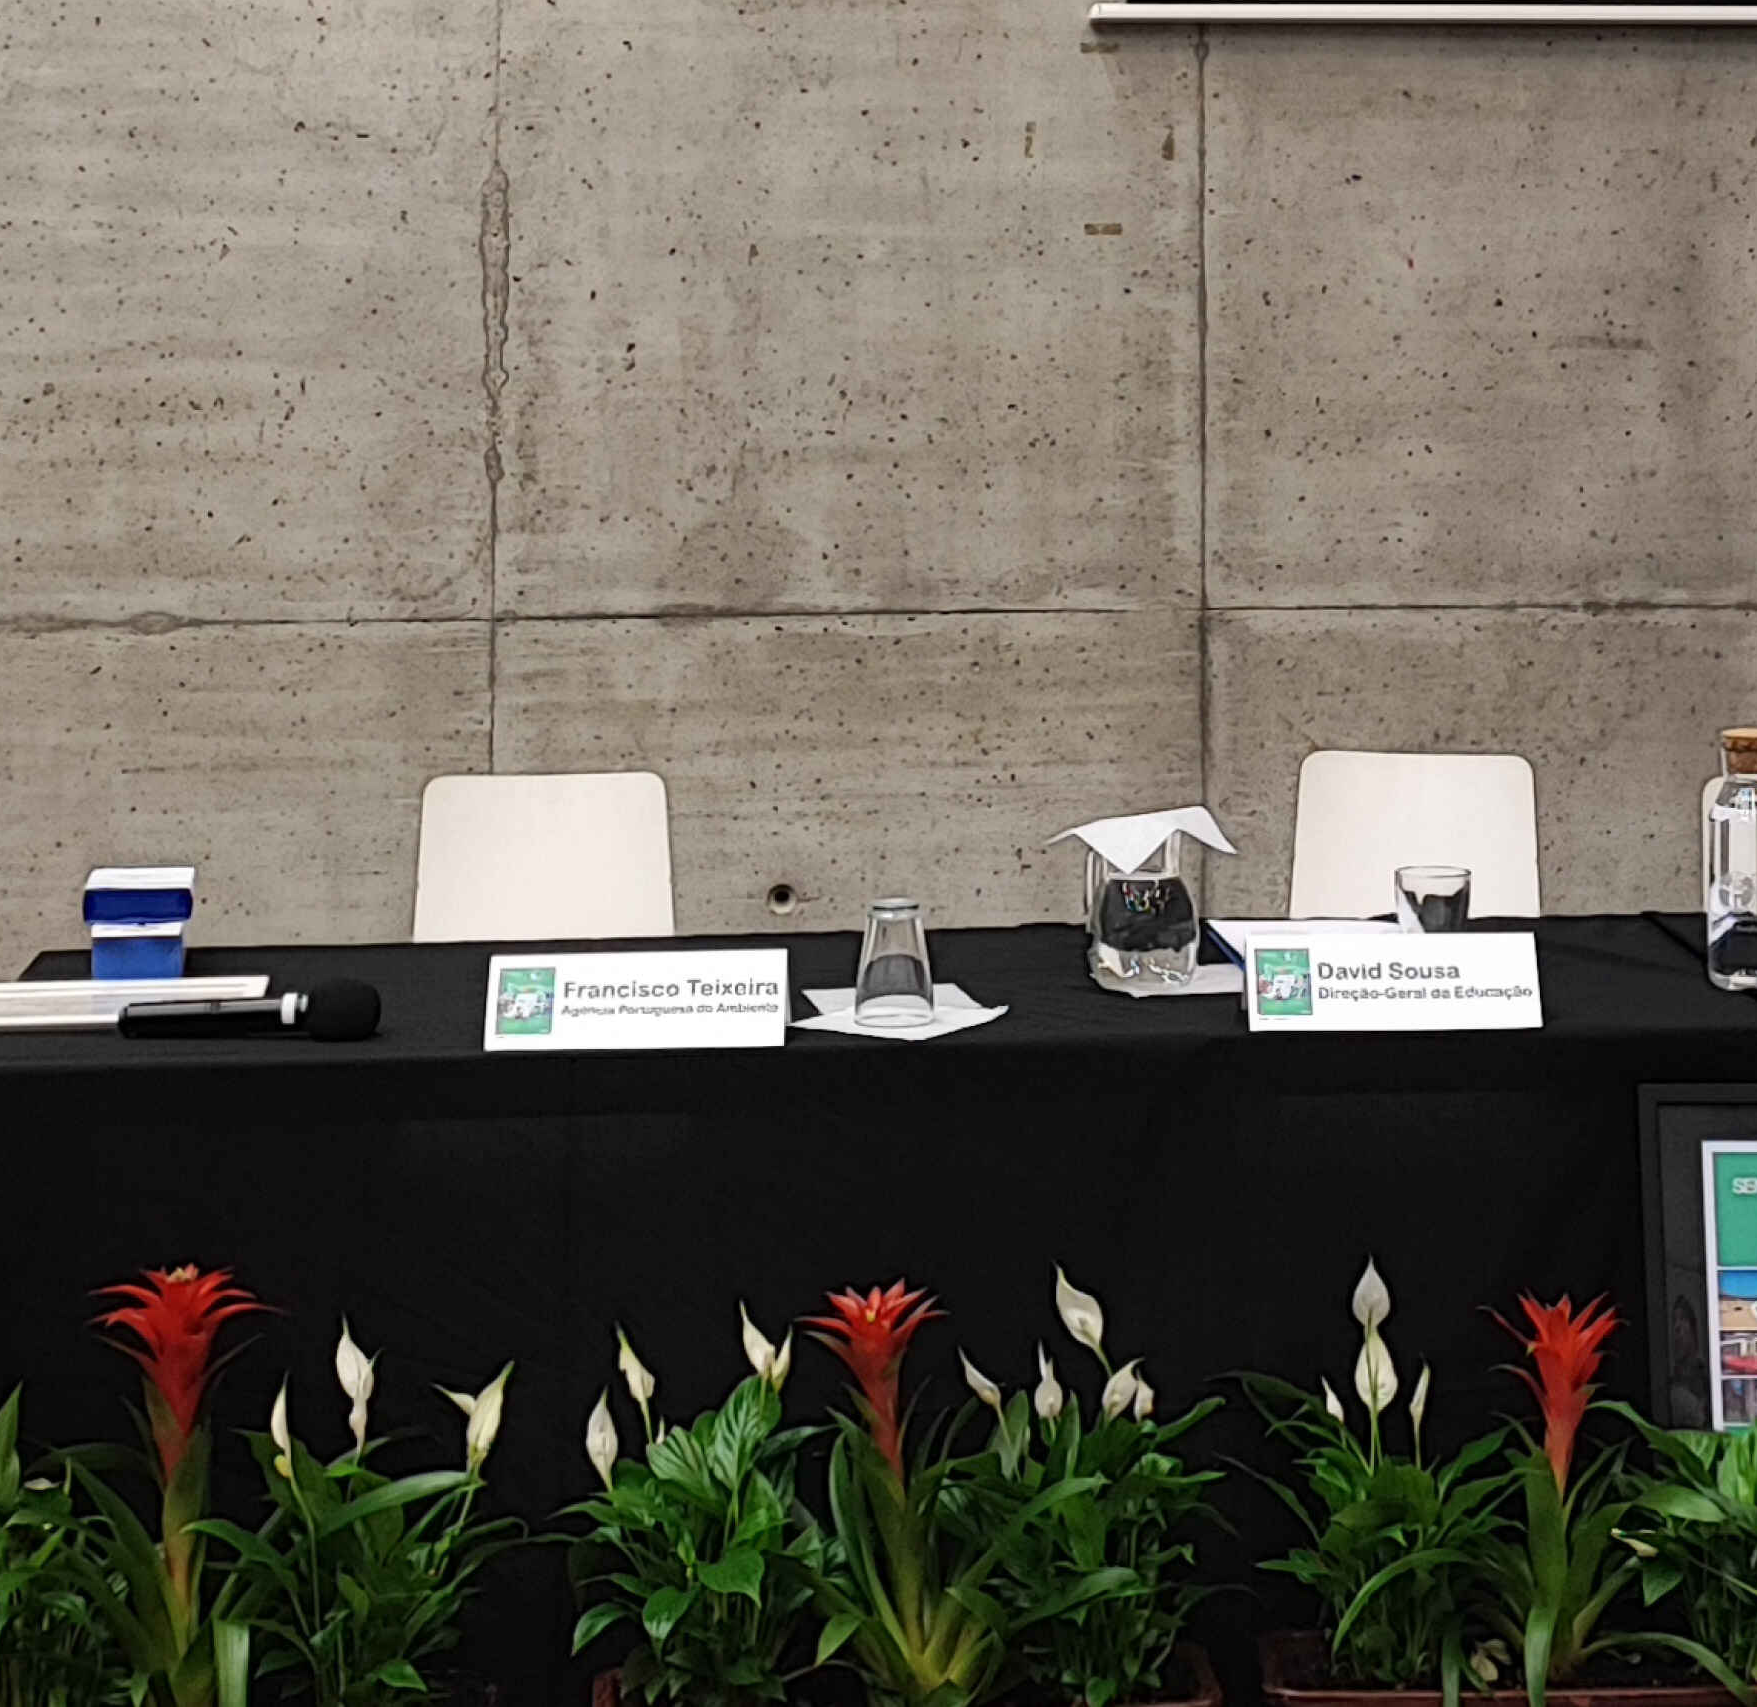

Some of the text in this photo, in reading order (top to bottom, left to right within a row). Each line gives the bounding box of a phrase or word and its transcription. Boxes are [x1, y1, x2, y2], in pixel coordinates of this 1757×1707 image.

[1317, 962, 1461, 980] David Sousa
[563, 978, 779, 999] Francisco Teixeira
[1454, 985, 1533, 1000] Educação
[618, 1004, 694, 1017] Portuguesa
[716, 1002, 779, 1014] Ambiente
